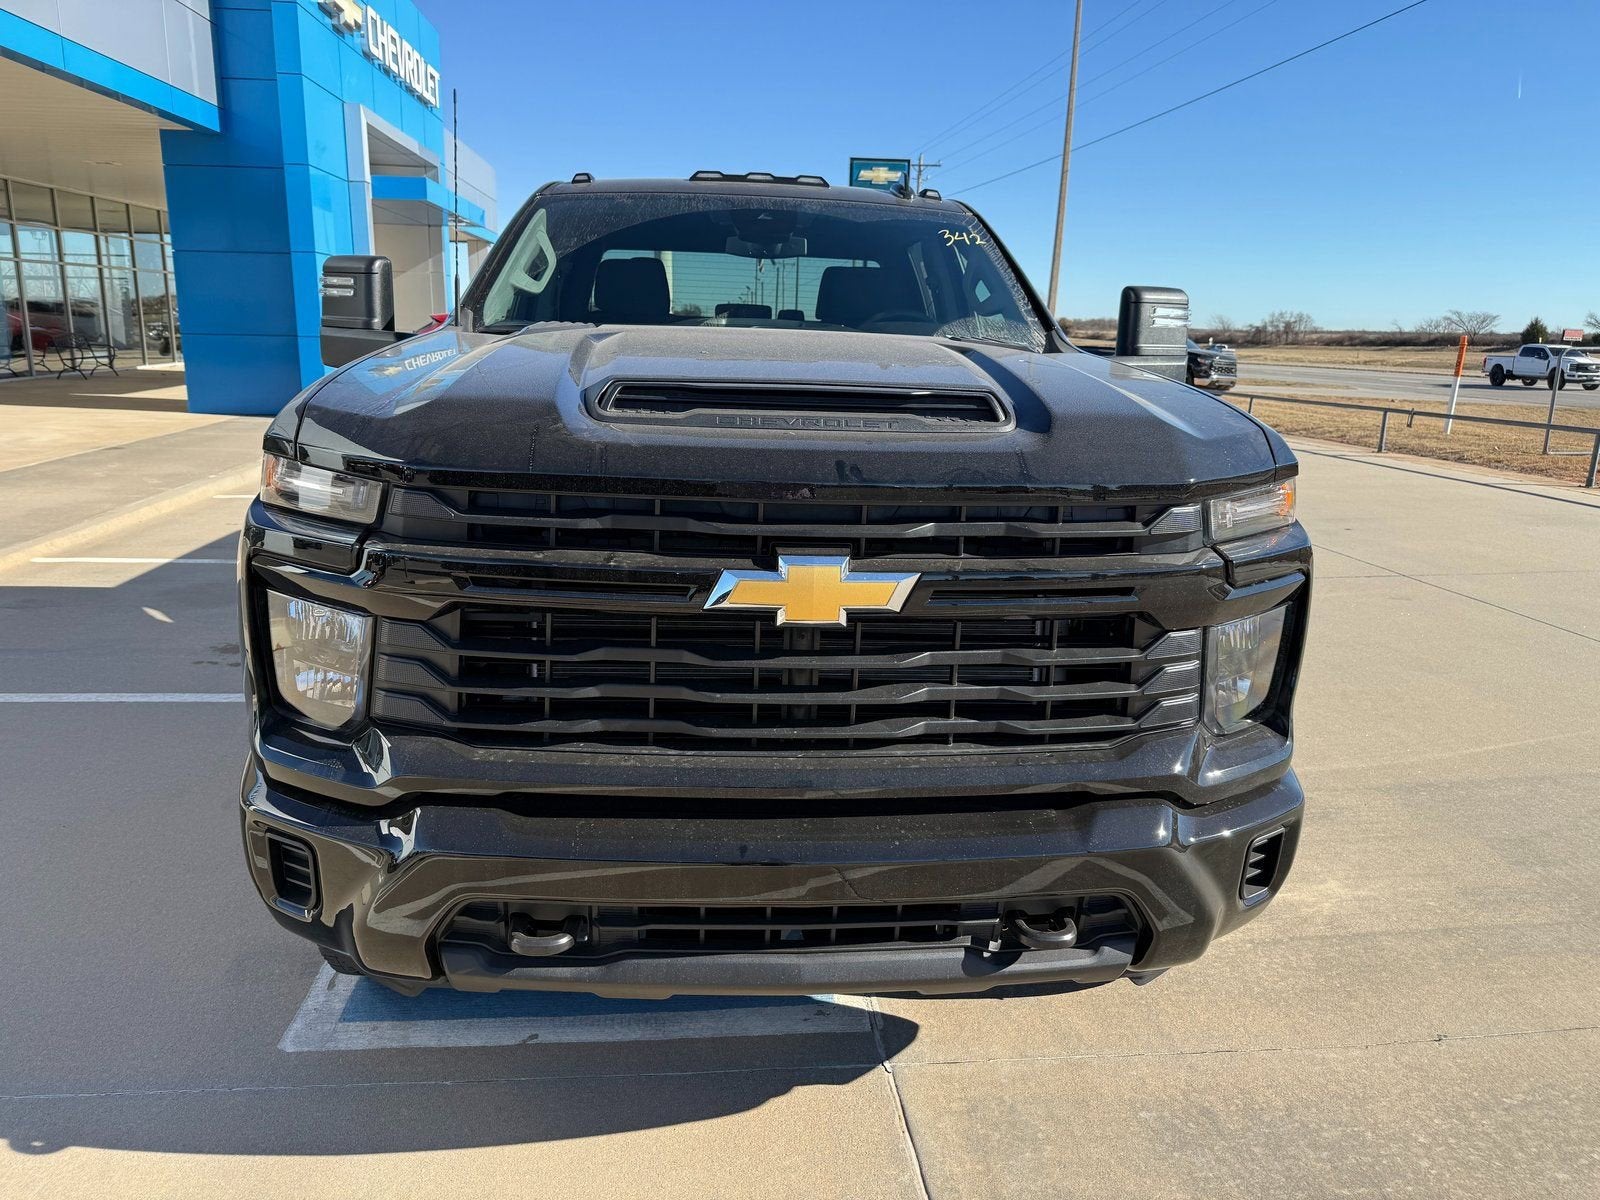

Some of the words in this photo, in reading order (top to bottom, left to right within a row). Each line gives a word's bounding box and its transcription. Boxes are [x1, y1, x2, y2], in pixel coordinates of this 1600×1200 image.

[365, 4, 442, 109] CHEVROLET
[937, 229, 987, 247] 342
[715, 415, 900, 430] CHEVROLET
